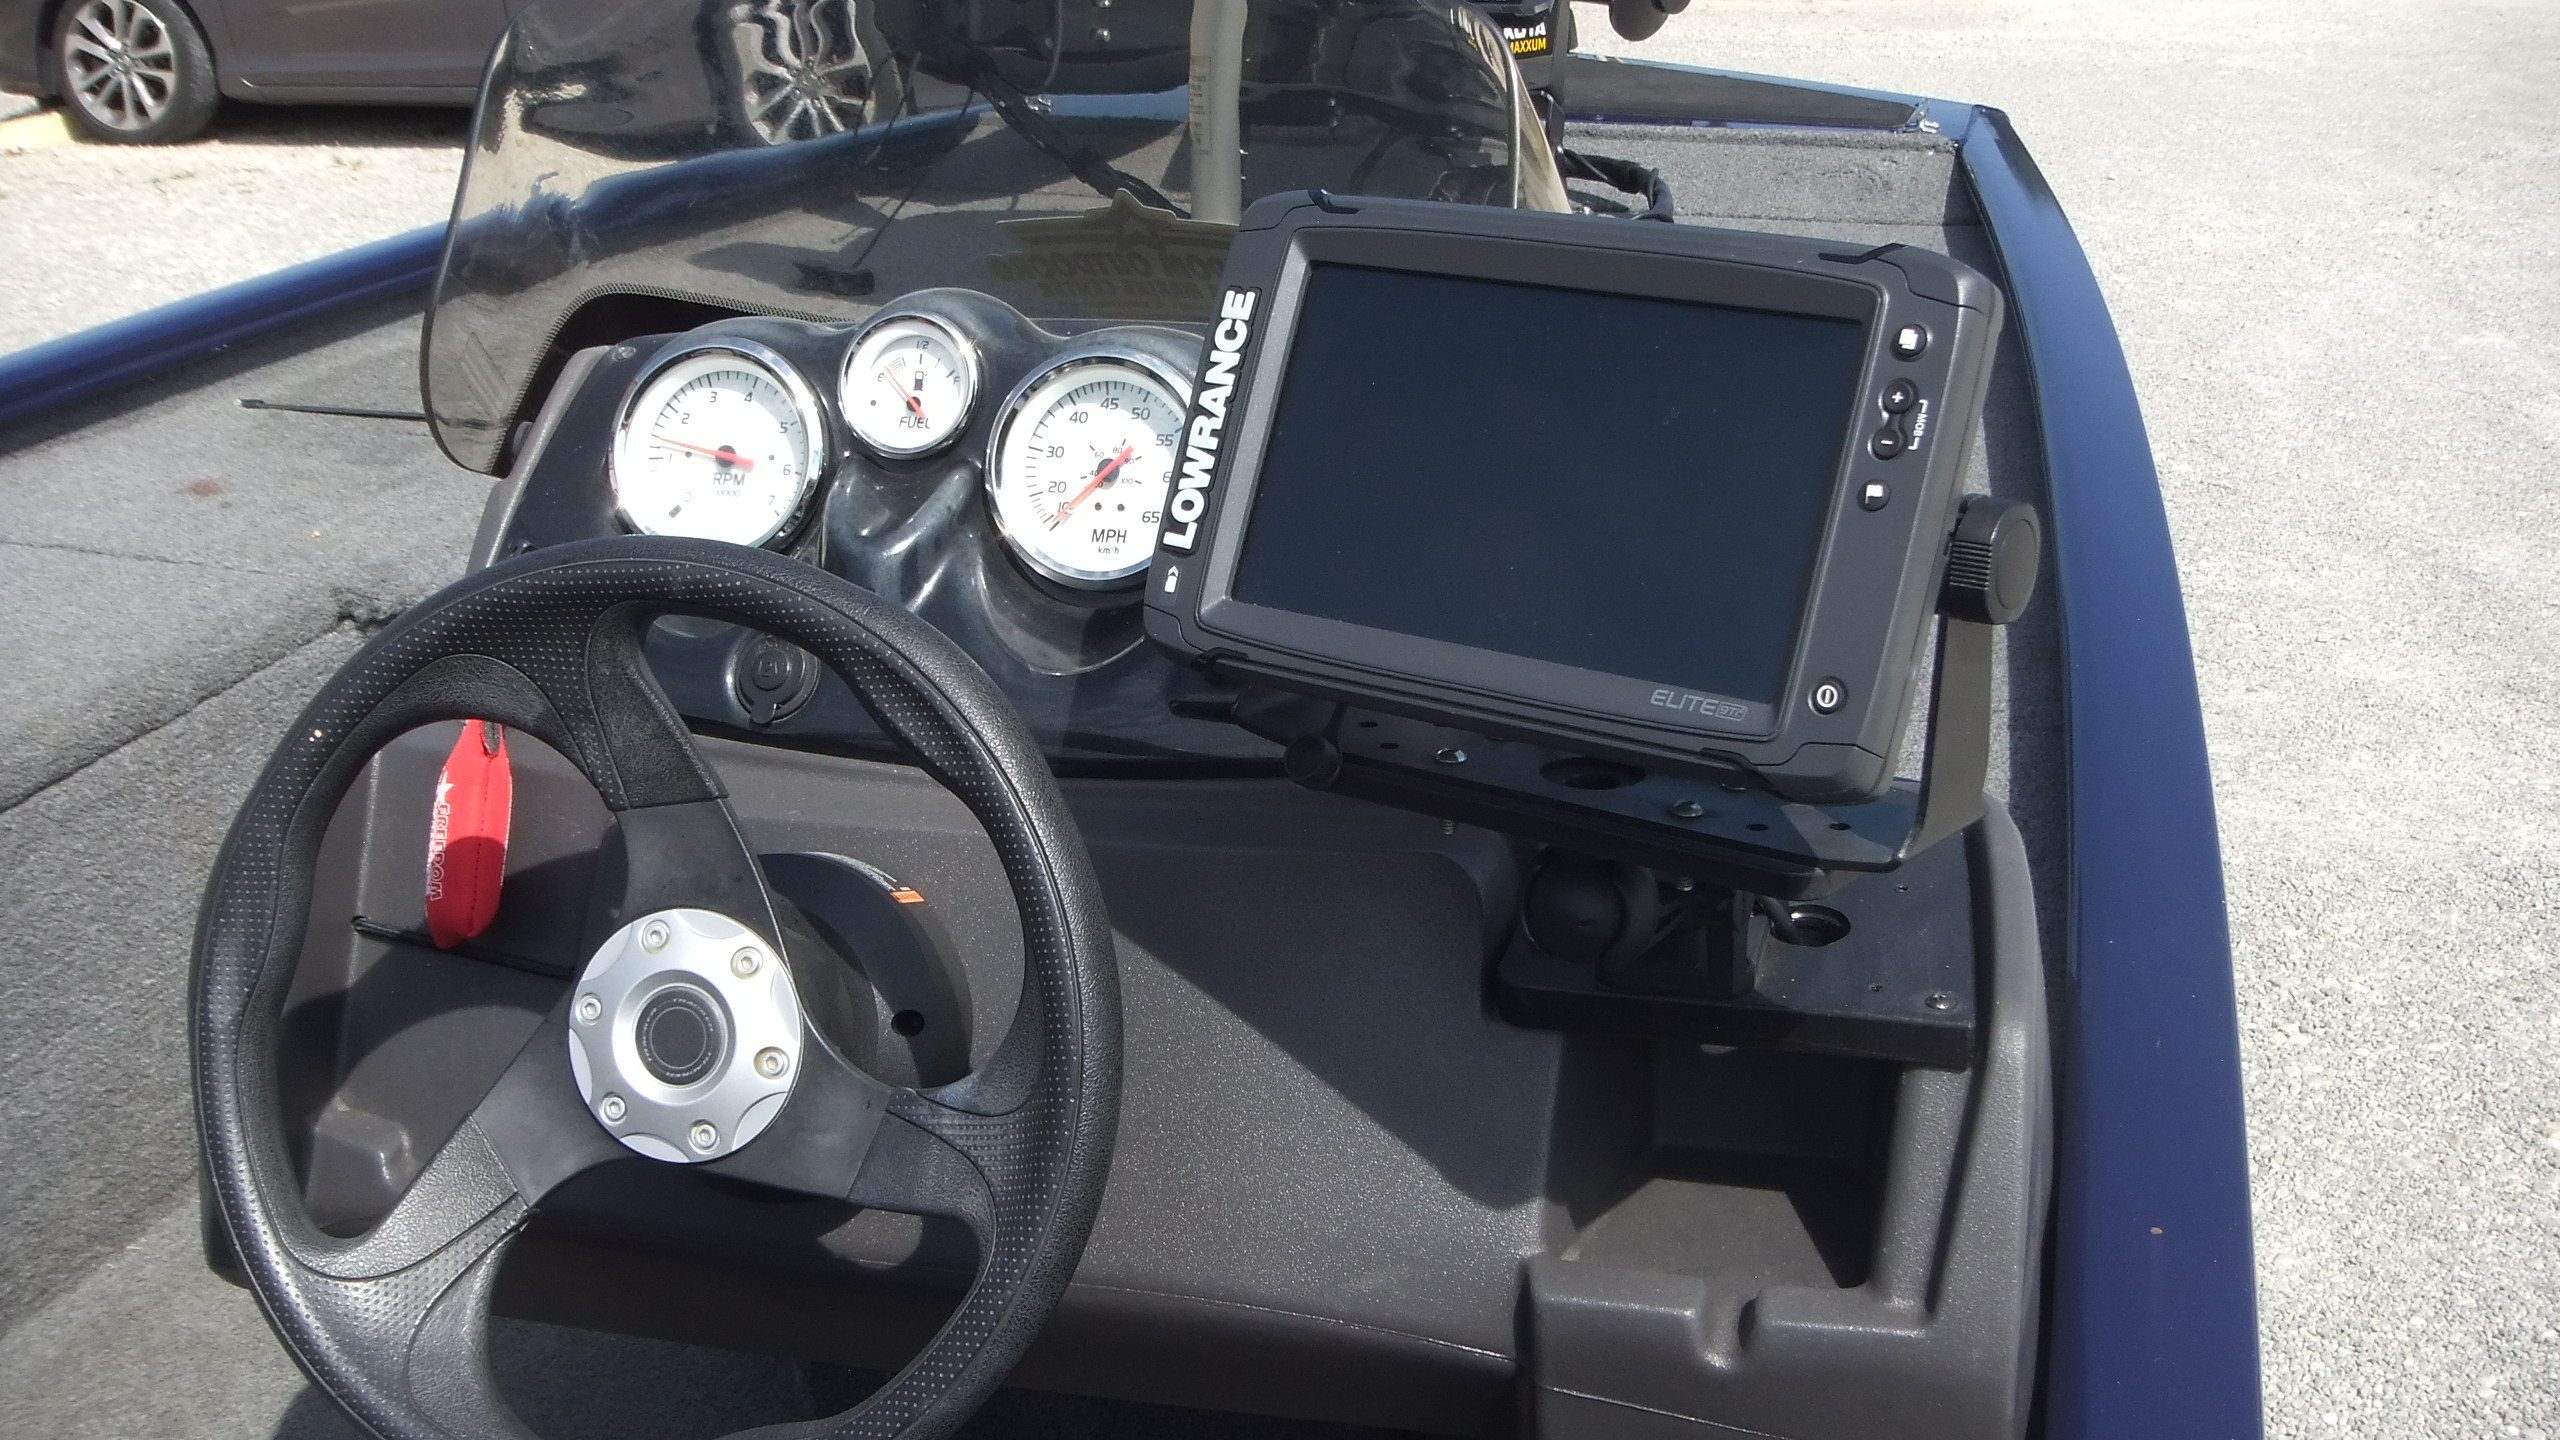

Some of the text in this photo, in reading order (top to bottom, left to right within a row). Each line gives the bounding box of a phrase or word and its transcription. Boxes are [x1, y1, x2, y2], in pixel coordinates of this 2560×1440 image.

[708, 391, 718, 403] 3
[743, 391, 754, 403] 4
[1100, 397, 1119, 410] 45
[681, 413, 690, 425] 2
[1069, 411, 1088, 423] 40
[1131, 408, 1150, 420] 50
[1163, 290, 1256, 550] LOWRANCE
[779, 422, 788, 434] 5
[899, 416, 931, 430] FUEL
[1913, 413, 1928, 437] MOB
[1155, 434, 1174, 447] 55
[1046, 446, 1065, 458] 30
[782, 464, 791, 476] 6
[713, 472, 746, 486] RPM
[1048, 481, 1067, 493] 20
[768, 494, 777, 506] 7
[1142, 511, 1160, 523] 65
[1091, 529, 1127, 543] MPH
[1650, 689, 1719, 716] ELITE
[430, 803, 451, 901] FREEDOM
